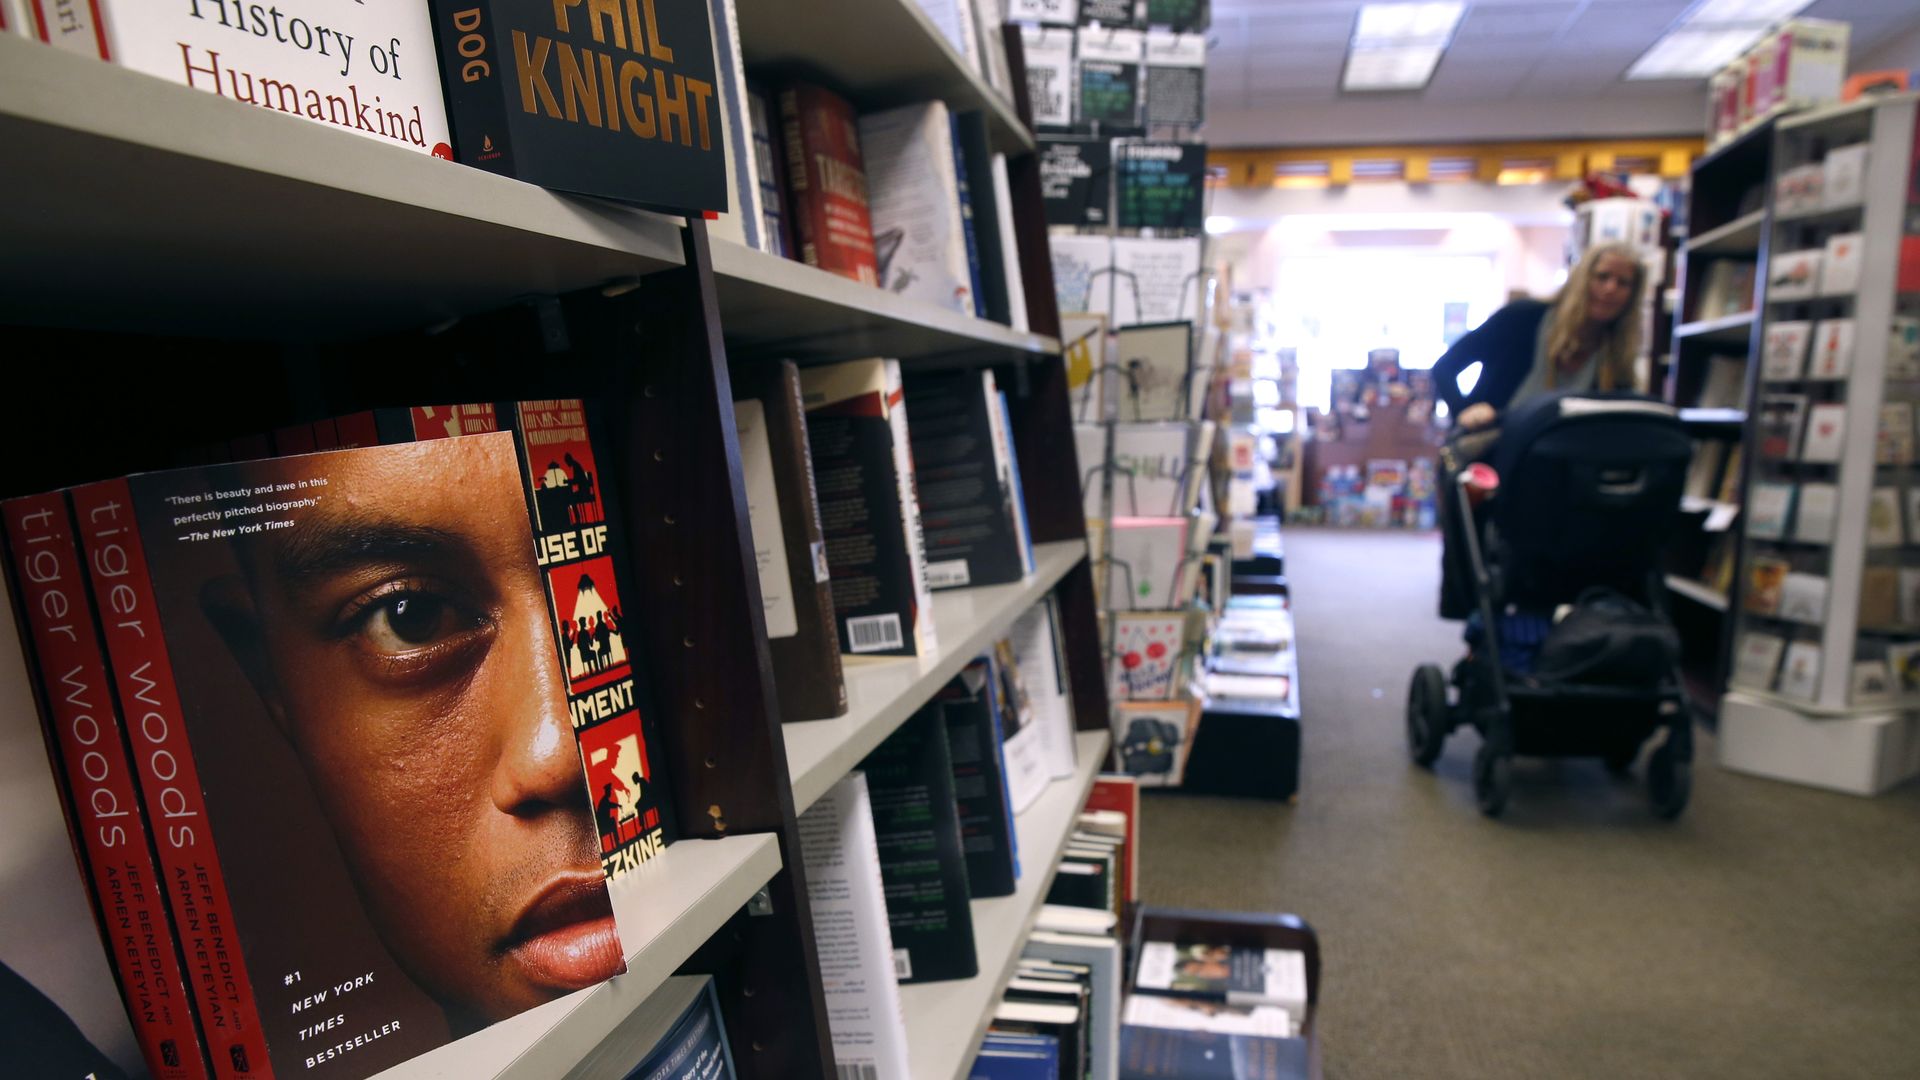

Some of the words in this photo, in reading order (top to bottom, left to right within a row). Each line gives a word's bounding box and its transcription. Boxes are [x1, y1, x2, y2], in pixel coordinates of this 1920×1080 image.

[190, 0, 354, 77] History
[369, 37, 403, 80] of
[453, 7, 490, 83] DOG
[554, 0, 674, 63] PHIL
[177, 41, 427, 148] Humankind
[512, 29, 712, 151] KNIGHT
[173, 511, 222, 526] perfectly
[224, 504, 263, 519] pitched
[204, 492, 213, 501] is
[216, 488, 251, 501] beauty
[254, 484, 273, 495] and
[276, 483, 296, 492] awe
[298, 480, 308, 489] in
[310, 477, 328, 487] this
[212, 528, 236, 539] New
[238, 523, 262, 534] York
[265, 519, 295, 531] Times
[582, 525, 608, 555] OF
[21, 508, 77, 643] tiger
[61, 665, 129, 848] woods
[90, 501, 145, 638] tiger
[129, 661, 198, 849] woods
[106, 866, 131, 929] ARMEN
[125, 935, 156, 1023] KETEYIAN
[125, 861, 145, 903] JEFF
[138, 910, 170, 999] BENEDICT
[176, 866, 200, 931] ARMEN
[194, 938, 226, 1028] KETEYIAN
[194, 863, 215, 906] JEFF
[207, 913, 240, 1003] BENEDICT
[284, 971, 302, 986] #1
[292, 990, 328, 1014] NEW
[334, 972, 374, 996] YORK
[299, 1014, 345, 1041] TIMES
[305, 1020, 401, 1069] BESTSELLER
